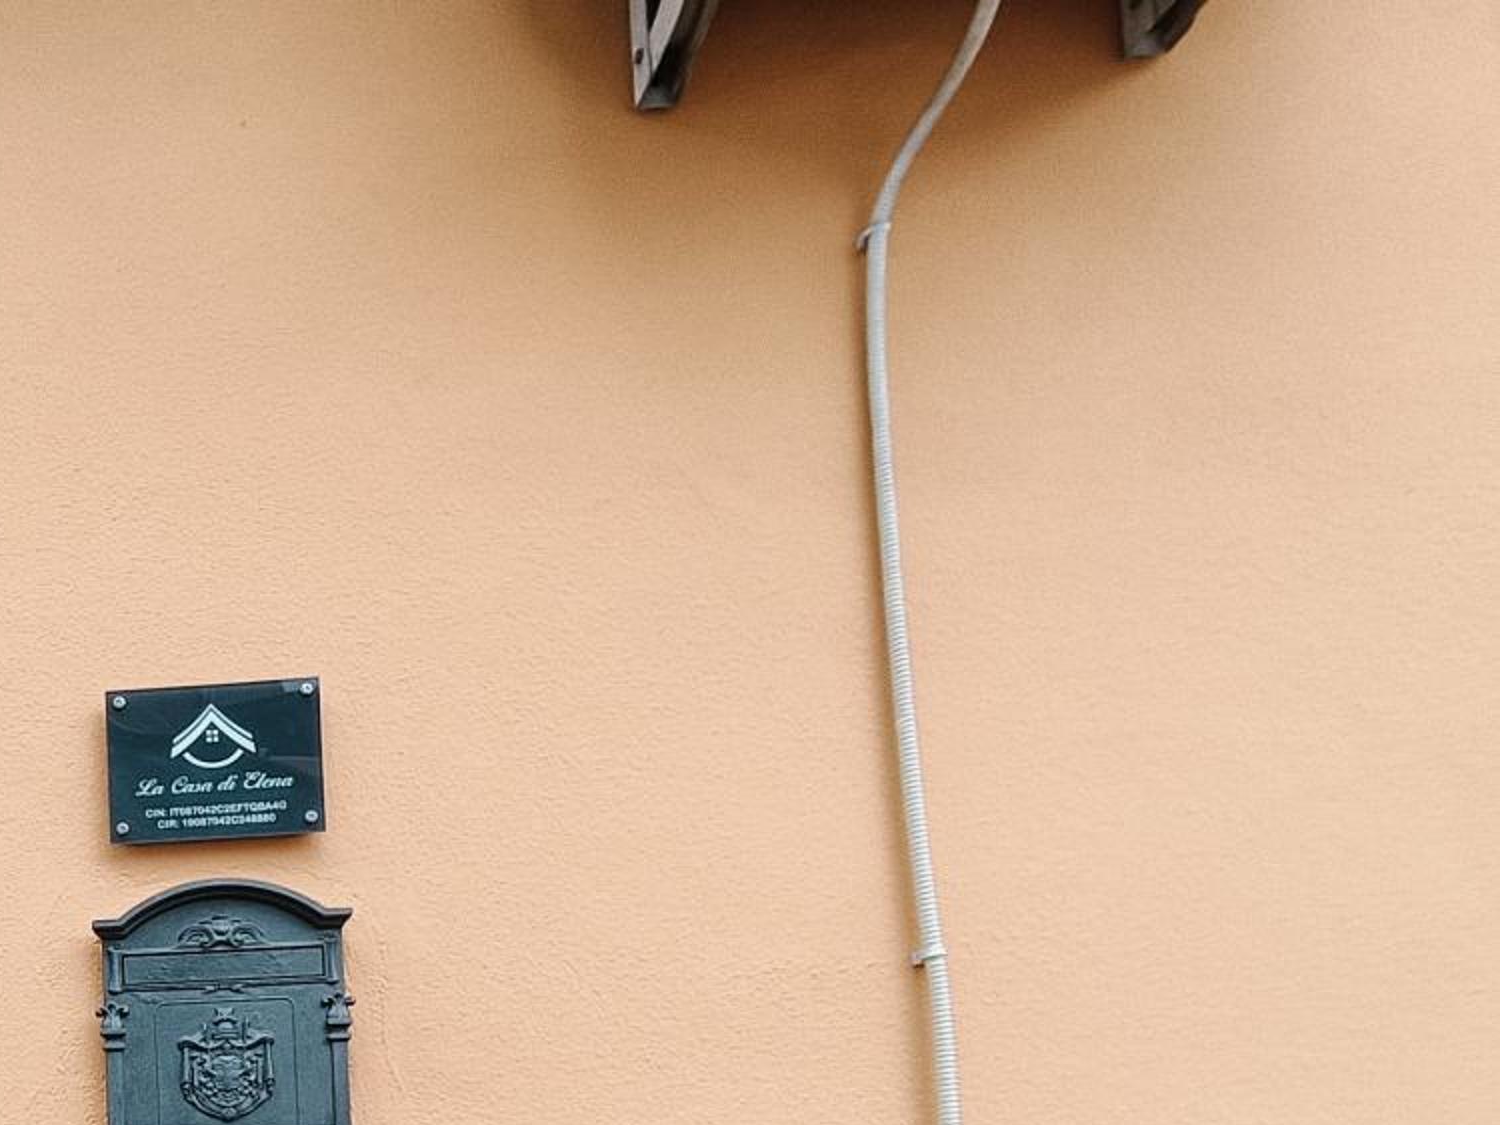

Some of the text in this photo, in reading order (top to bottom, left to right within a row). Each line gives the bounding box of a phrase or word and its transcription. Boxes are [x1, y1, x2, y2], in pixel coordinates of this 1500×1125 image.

[135, 770, 294, 797] La Casa di Elena
